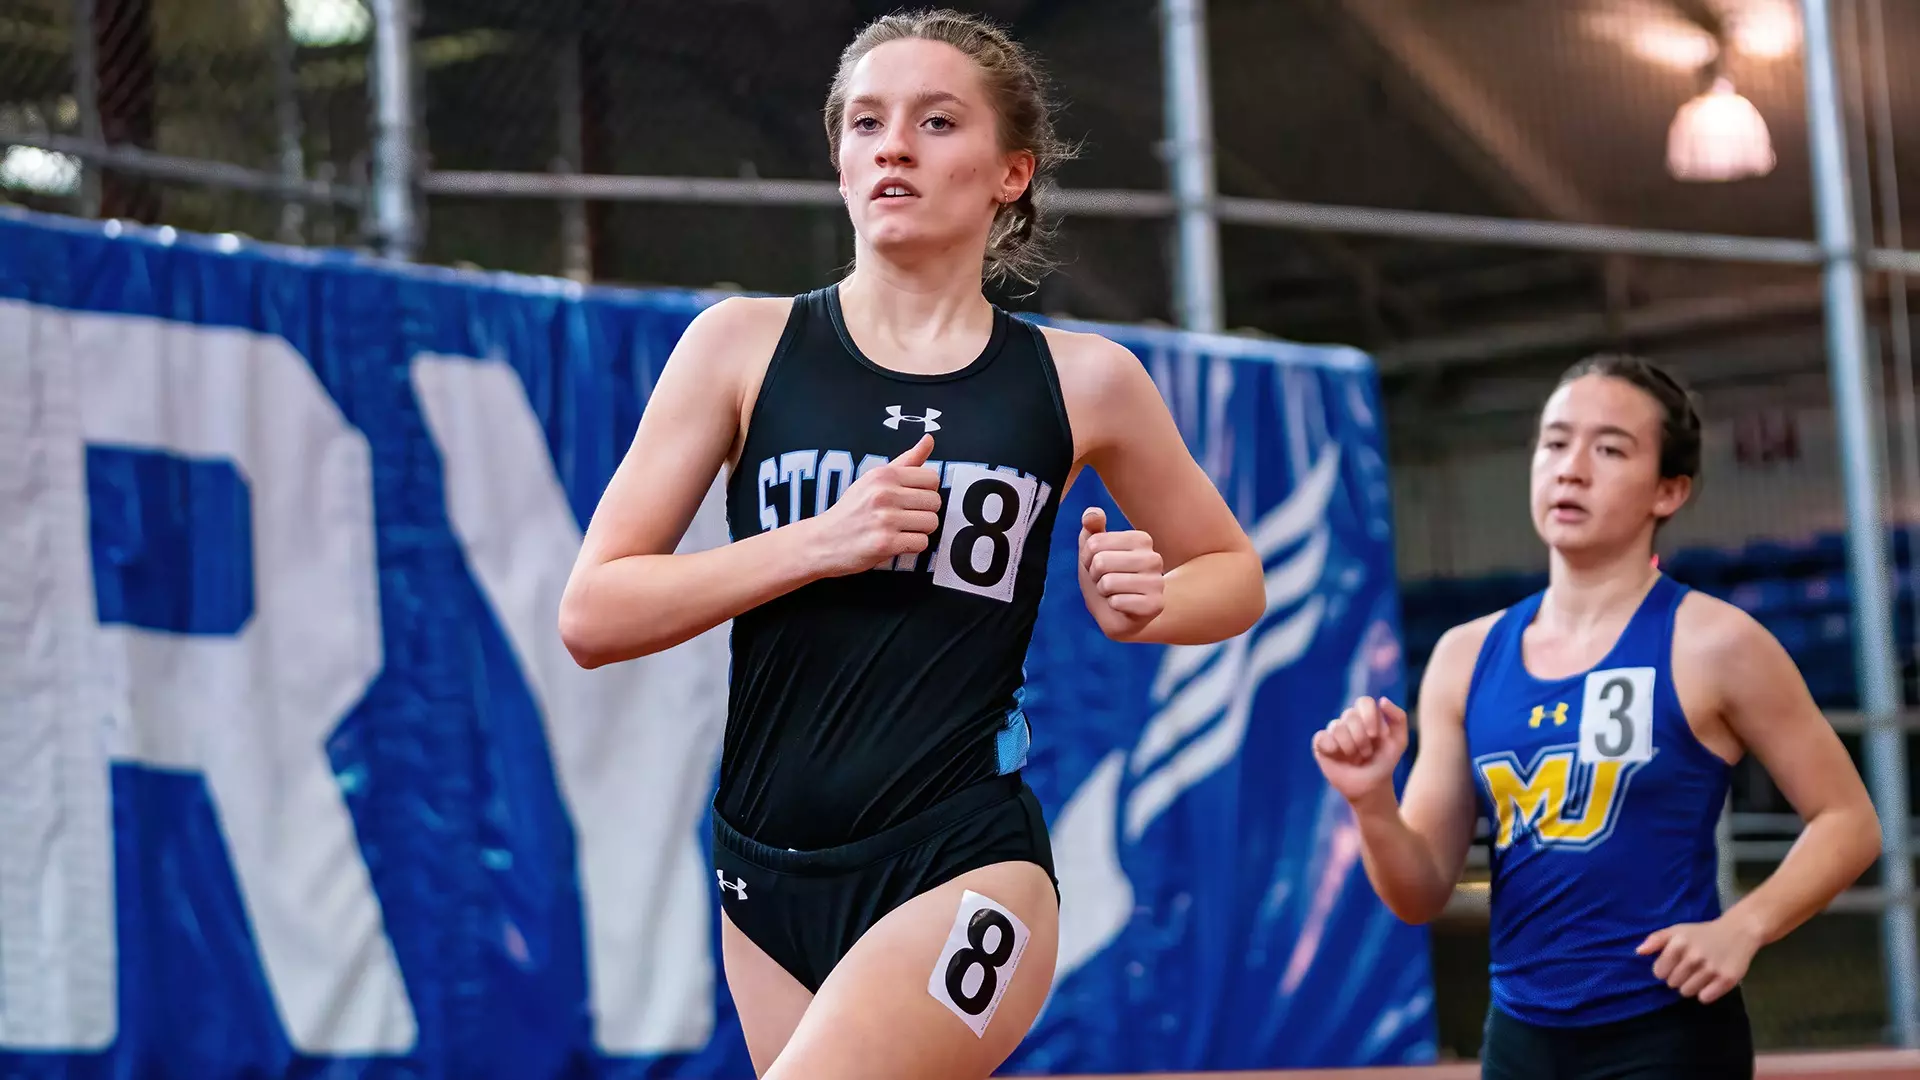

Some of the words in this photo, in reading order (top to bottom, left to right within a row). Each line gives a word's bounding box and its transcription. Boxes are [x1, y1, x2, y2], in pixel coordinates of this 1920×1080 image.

[950, 478, 1020, 587] 8
[1595, 676, 1636, 758] 3
[945, 908, 1015, 1015] 8
